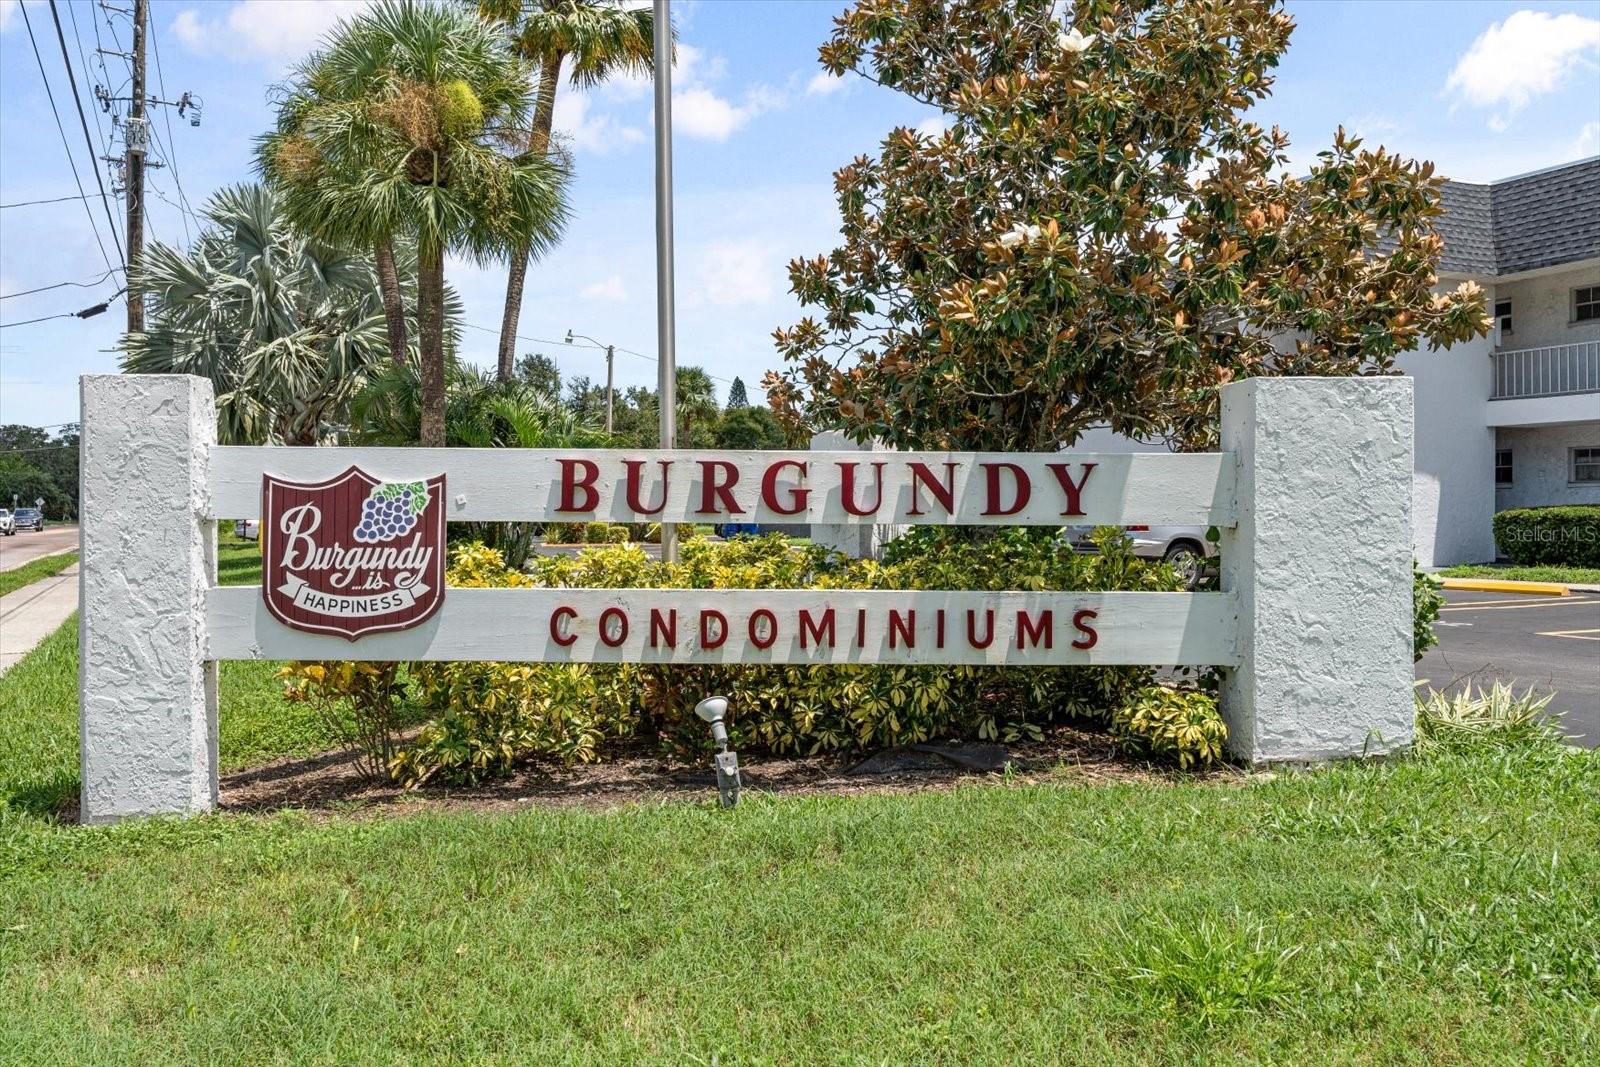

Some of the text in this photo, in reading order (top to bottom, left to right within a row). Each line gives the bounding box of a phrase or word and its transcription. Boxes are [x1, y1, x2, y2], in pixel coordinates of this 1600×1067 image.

[554, 459, 1099, 516] BURGUNDY
[280, 501, 434, 589] Burgundy
[303, 592, 404, 613] HAPPINESS
[549, 606, 1099, 650] CONDOMINIUMS
